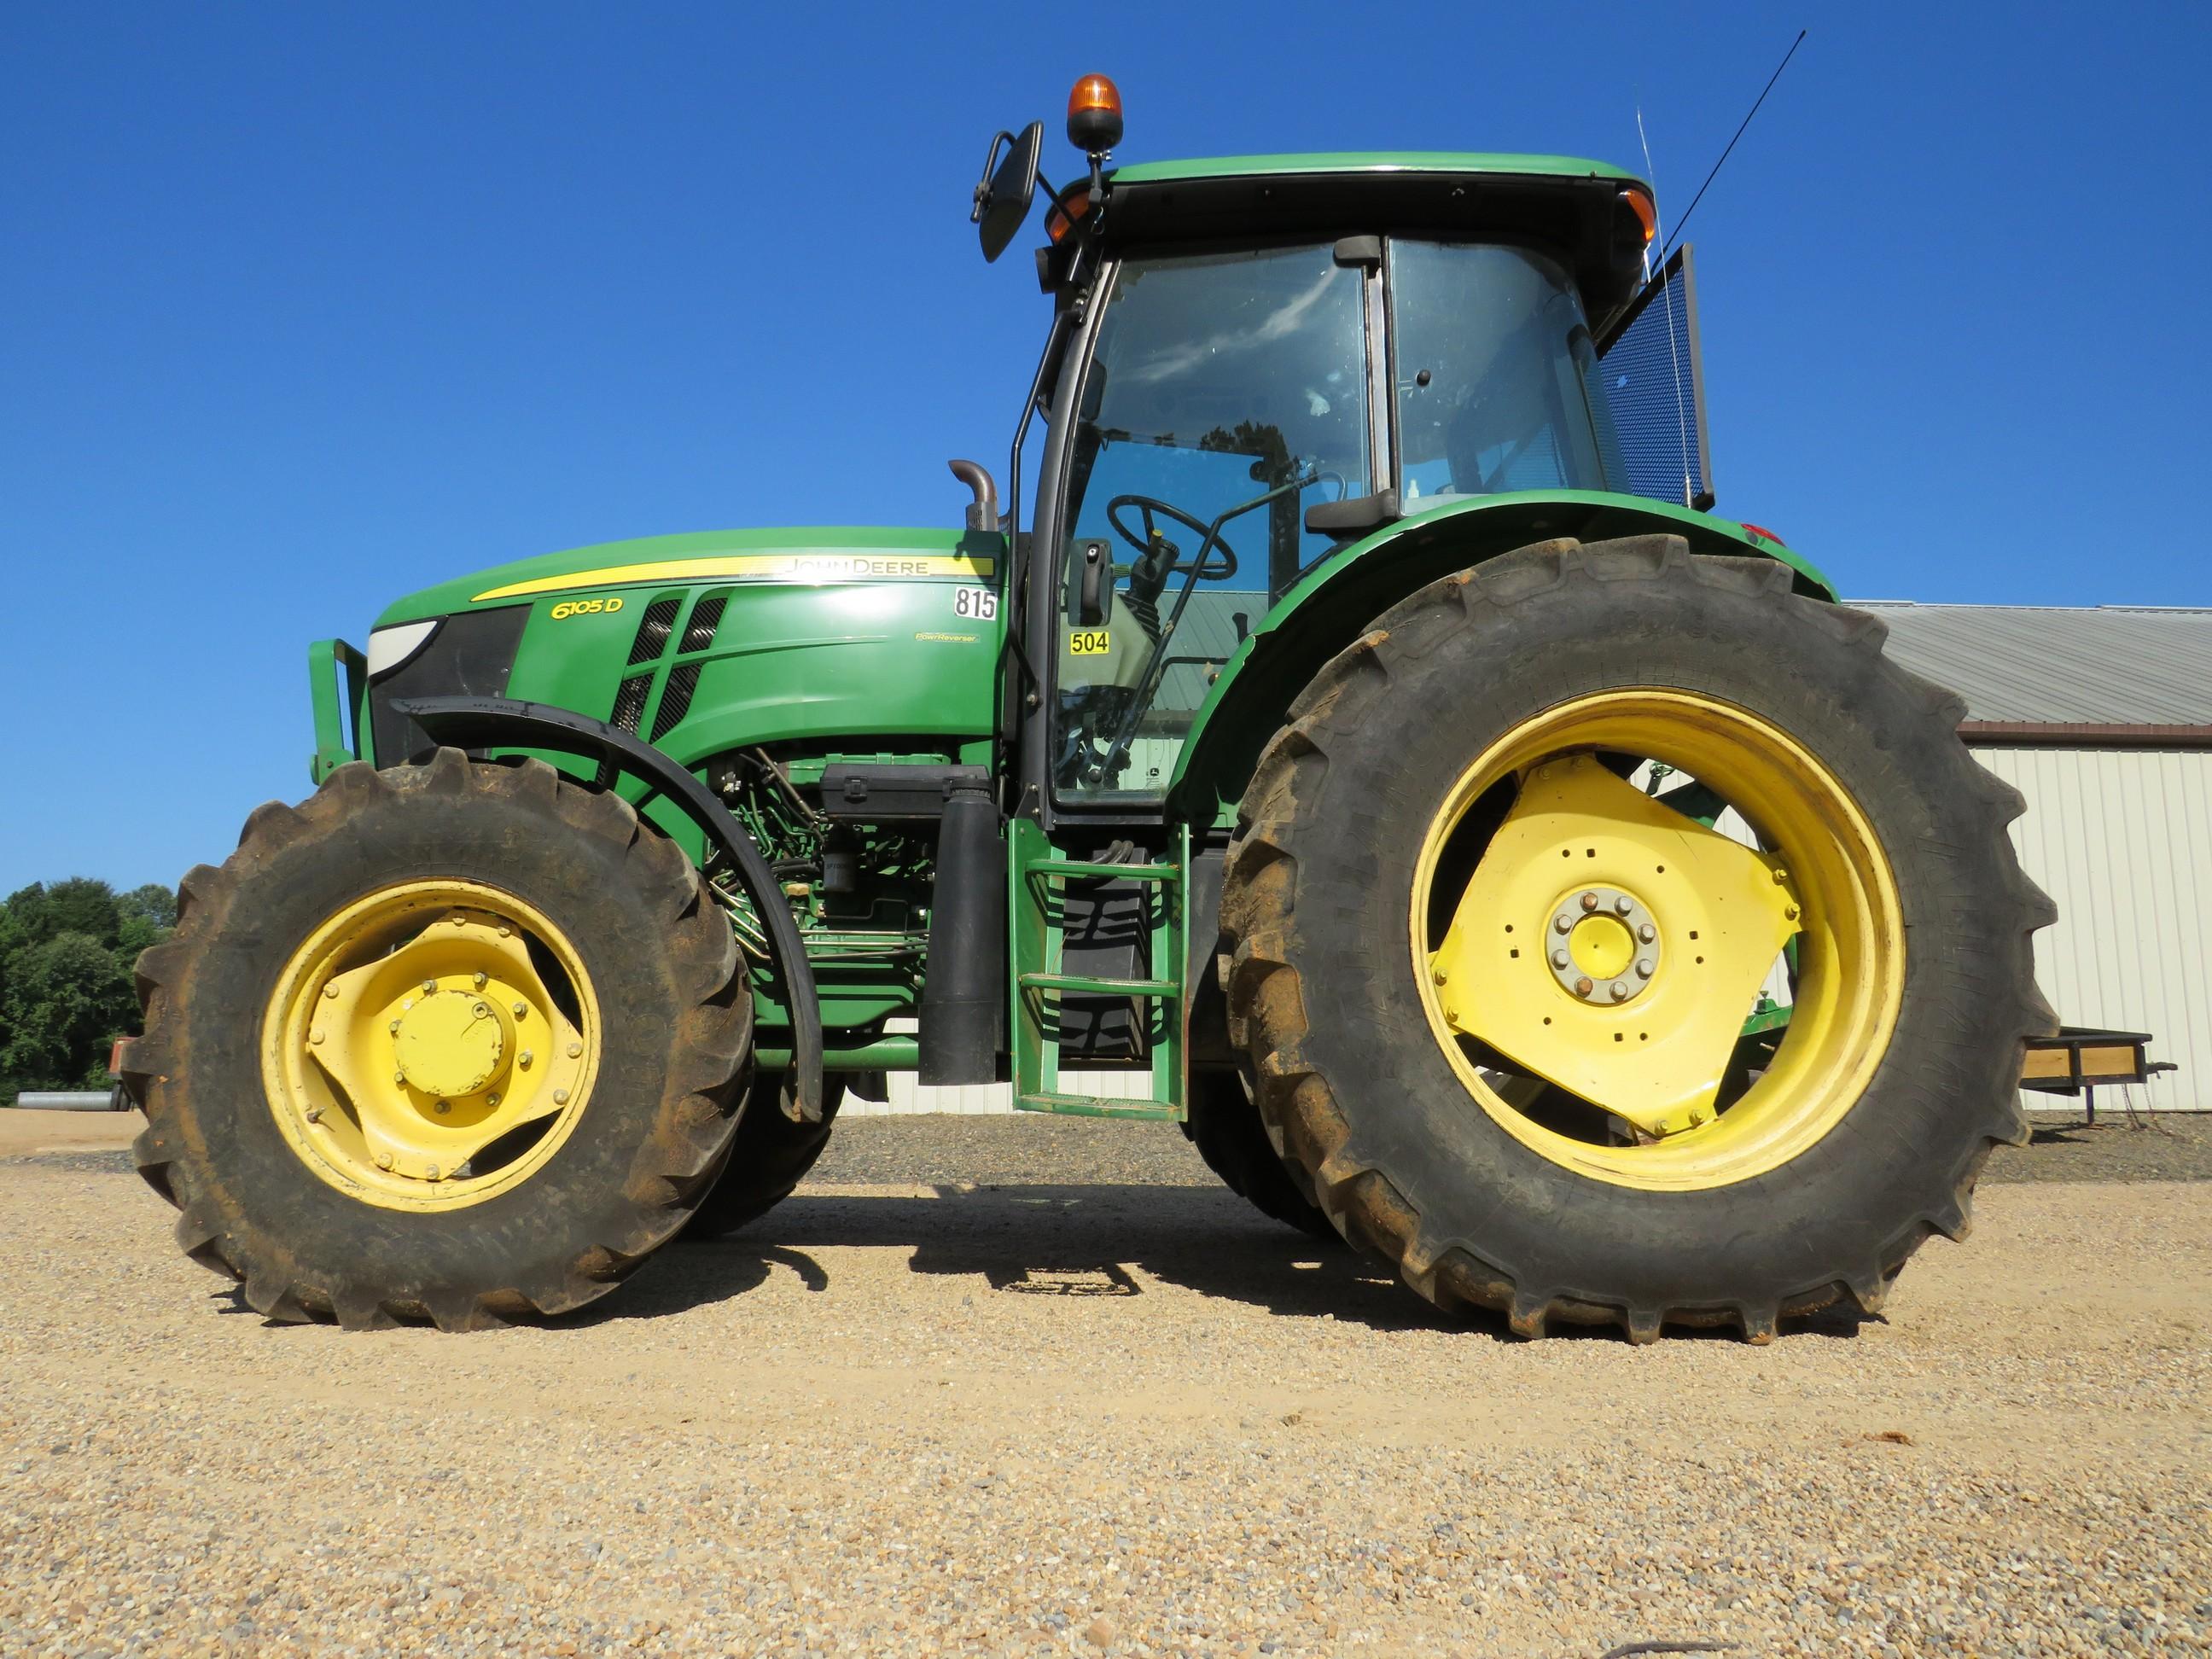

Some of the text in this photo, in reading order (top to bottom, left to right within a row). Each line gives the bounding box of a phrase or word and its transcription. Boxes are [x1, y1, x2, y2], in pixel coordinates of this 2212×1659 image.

[853, 559, 928, 574] DEERE
[956, 589, 995, 619] 815
[915, 632, 976, 643] PowrReverser
[1072, 632, 1108, 652] 504
